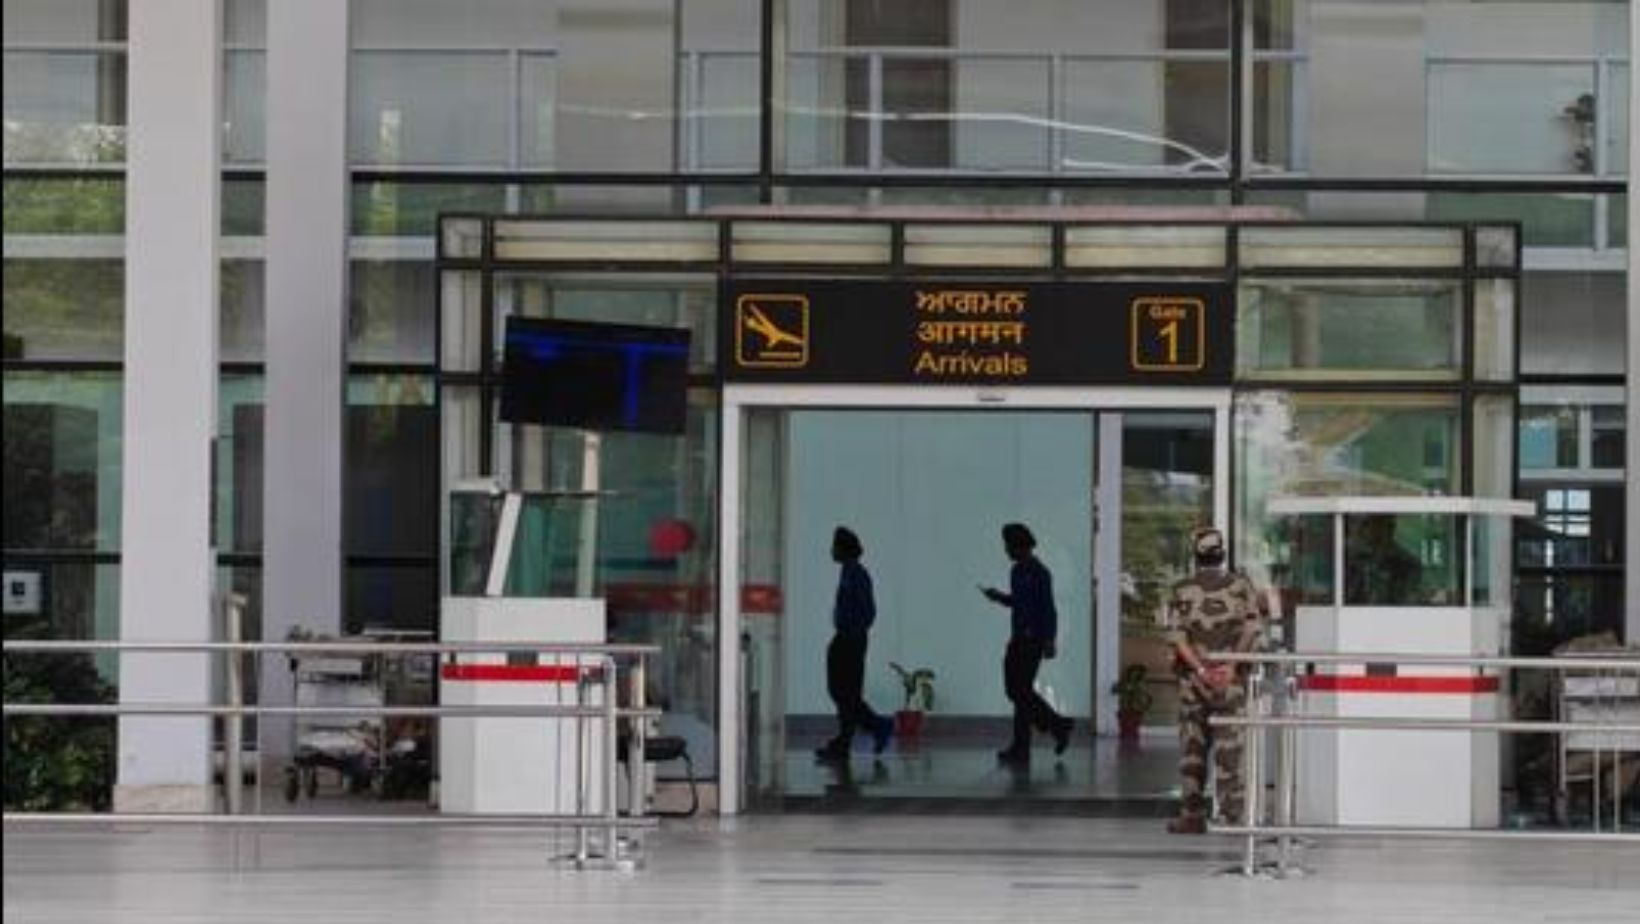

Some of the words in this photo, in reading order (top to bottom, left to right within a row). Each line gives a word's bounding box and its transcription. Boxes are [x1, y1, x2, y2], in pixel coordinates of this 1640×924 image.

[915, 290, 1027, 314] ਆਗਮਨ
[1149, 304, 1187, 320] Gate
[918, 321, 1025, 345] आगमन
[1158, 320, 1178, 363] 1
[914, 350, 1028, 375] Arrivals
